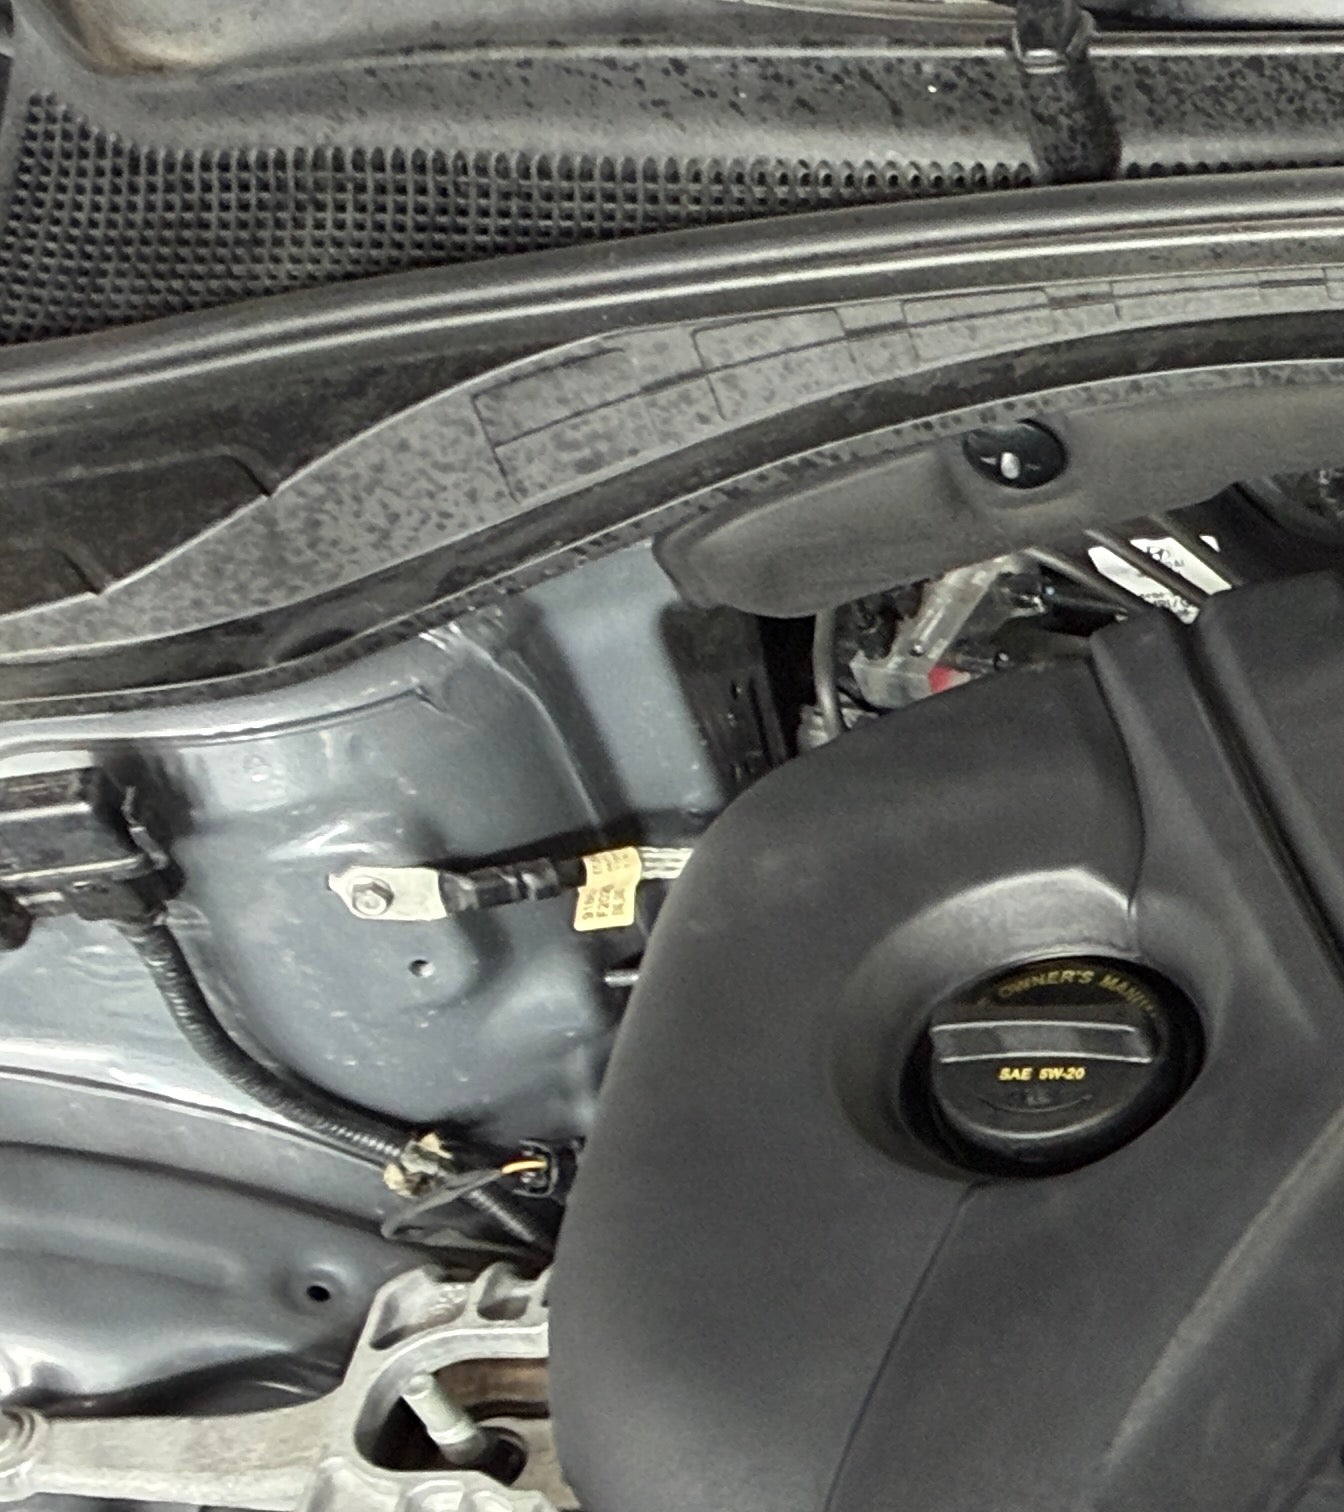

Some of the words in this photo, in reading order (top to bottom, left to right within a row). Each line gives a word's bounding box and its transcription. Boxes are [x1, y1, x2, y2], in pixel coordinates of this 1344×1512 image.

[997, 969, 1095, 999] OWNER'S
[998, 1066, 1033, 1081] SAE
[1038, 1066, 1087, 1081] 5W-20
